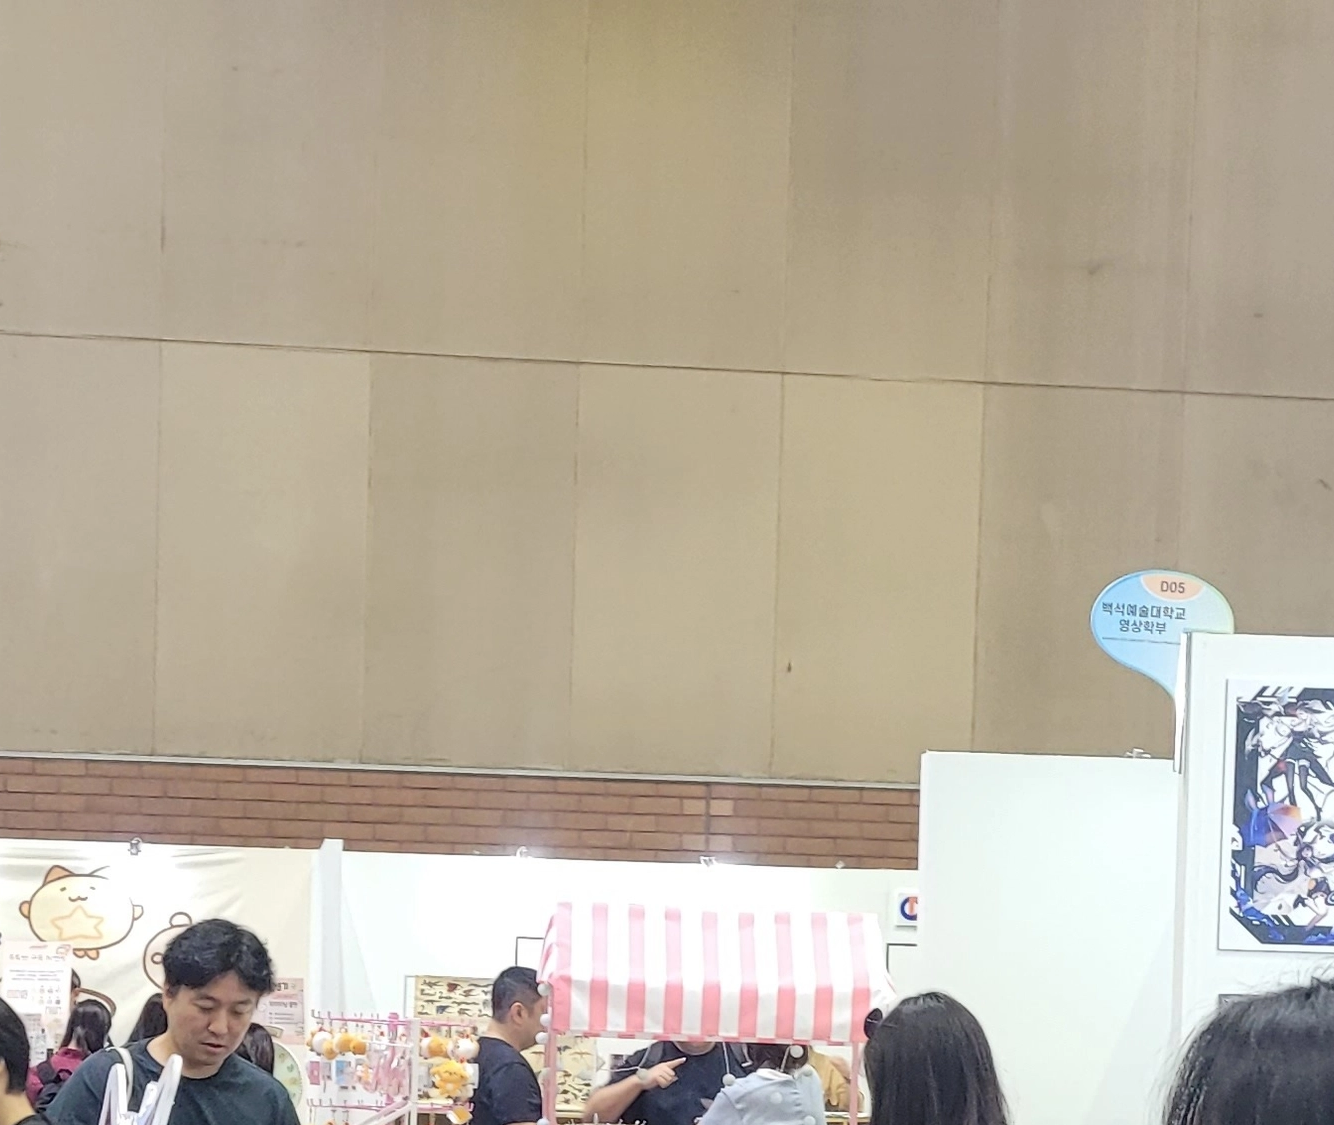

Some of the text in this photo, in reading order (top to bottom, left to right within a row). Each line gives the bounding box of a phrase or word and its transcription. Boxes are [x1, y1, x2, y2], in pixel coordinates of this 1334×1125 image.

[1160, 580, 1186, 594] D05
[1101, 601, 1187, 620] 백석예술대학교
[1118, 619, 1167, 635] 영상학부
